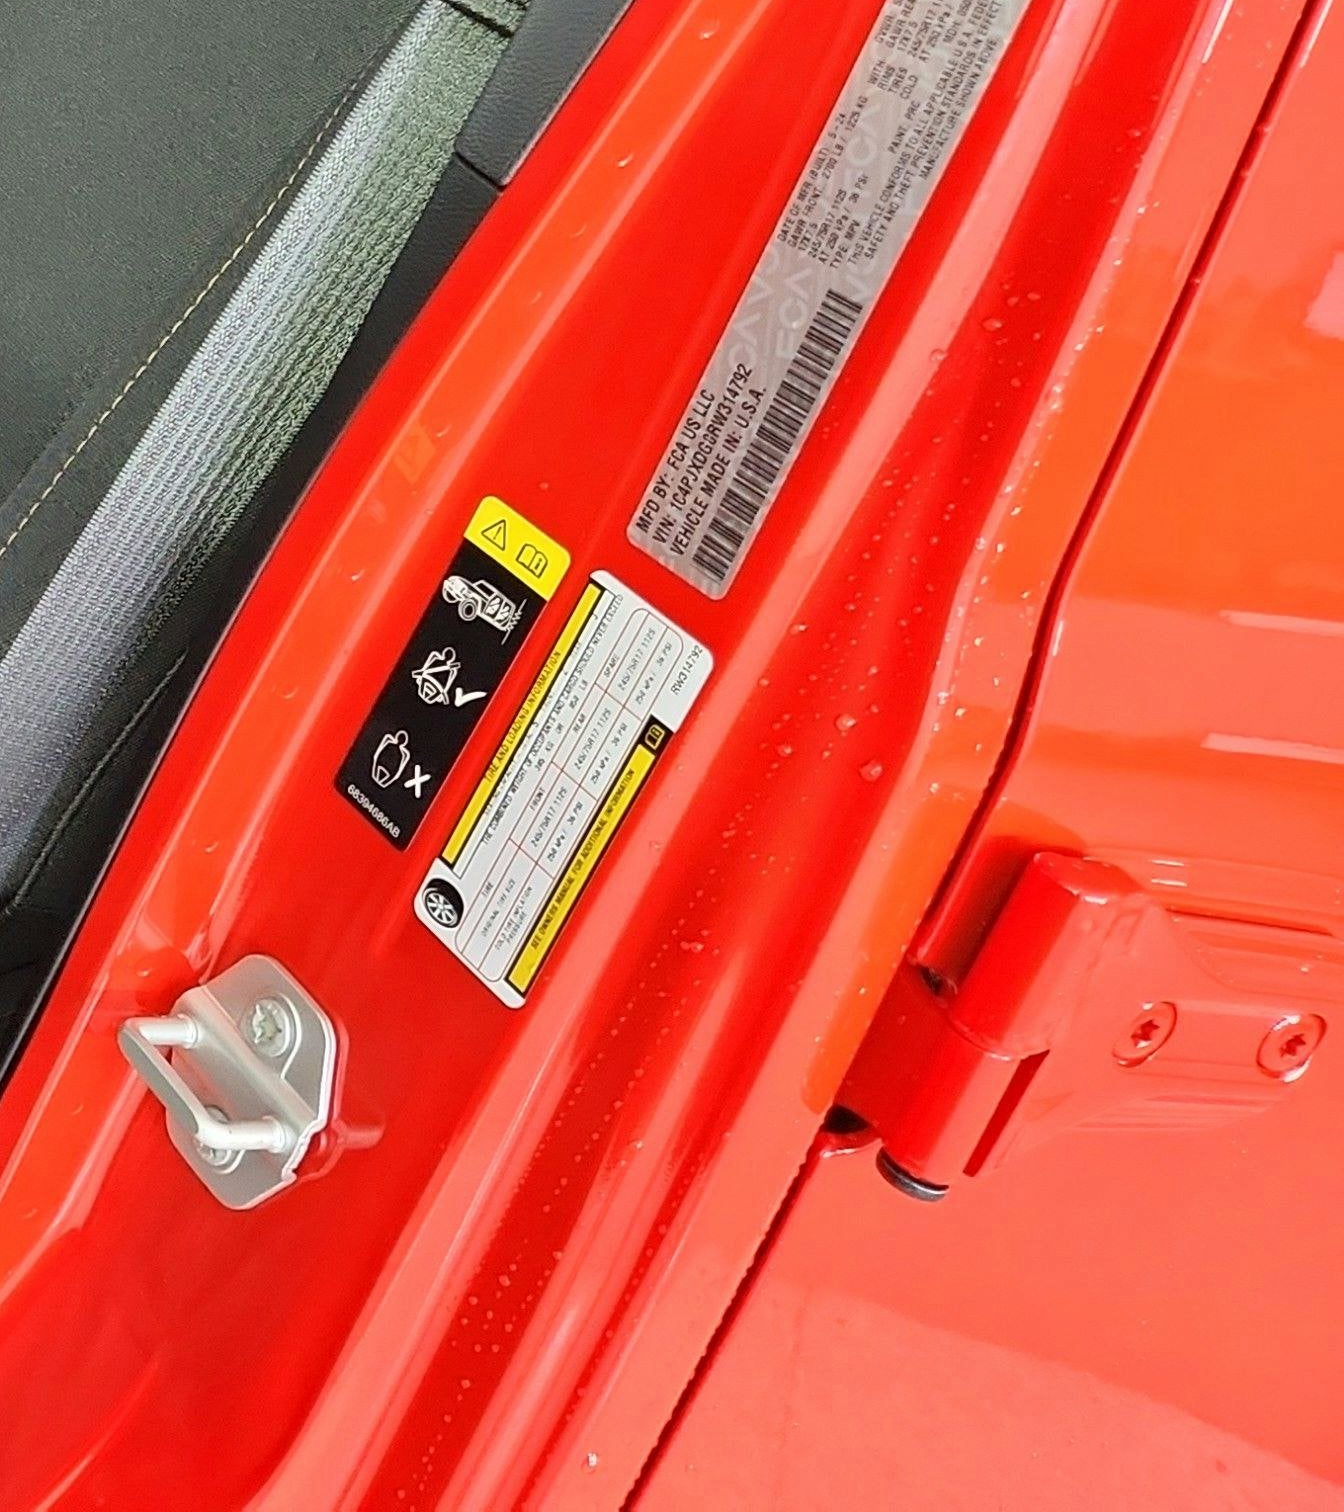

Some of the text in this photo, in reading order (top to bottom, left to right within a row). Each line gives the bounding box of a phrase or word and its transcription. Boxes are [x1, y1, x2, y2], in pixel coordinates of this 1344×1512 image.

[884, 17, 907, 49] GAWR
[917, 48, 931, 63] AT
[876, 64, 896, 91] RIMS
[887, 65, 908, 95] TIRES
[863, 223, 888, 260] SAFETY
[882, 200, 900, 223] AND
[893, 169, 916, 200] THEFT
[909, 108, 947, 169] PREVENTION
[939, 49, 977, 109] STANDARDS
[970, 36, 983, 49] IN
[917, 107, 962, 181] MANUFACTURE
[954, 70, 980, 108] SHOWN
[786, 217, 807, 248] GAWR
[820, 156, 838, 180] 2700
[831, 142, 845, 157] LB
[843, 109, 861, 132] 1225
[854, 93, 869, 110] KG
[866, 57, 887, 86] WITH
[817, 250, 830, 264] AT
[898, 72, 919, 101] COLD
[846, 241, 865, 266] THIS
[858, 202, 885, 243] VEHICLE
[878, 150, 912, 204] CONFORMS
[904, 134, 919, 151] TO
[912, 115, 929, 136] ALL
[922, 56, 959, 116] APPLICABLE
[776, 216, 795, 242] DATE
[788, 202, 802, 217] OF
[796, 180, 813, 202] MFR
[843, 218, 861, 241] MPV
[634, 387, 715, 533] MFD BY: FCA US LLC
[669, 381, 766, 556] VEHICLE MADE IN: U.S.A.
[652, 512, 677, 545] VIN:
[602, 652, 620, 678] SPARE
[669, 643, 703, 695] RW314792
[484, 649, 561, 782] TIRE AND LOADING INFORMATION
[572, 712, 586, 733] REAR
[528, 786, 545, 811] FRONT
[554, 875, 574, 905] MANUAL
[570, 858, 584, 875] FOR
[580, 817, 606, 859] ADDITIONAL
[603, 767, 635, 818] INFORMATION
[481, 881, 493, 898] TIRE
